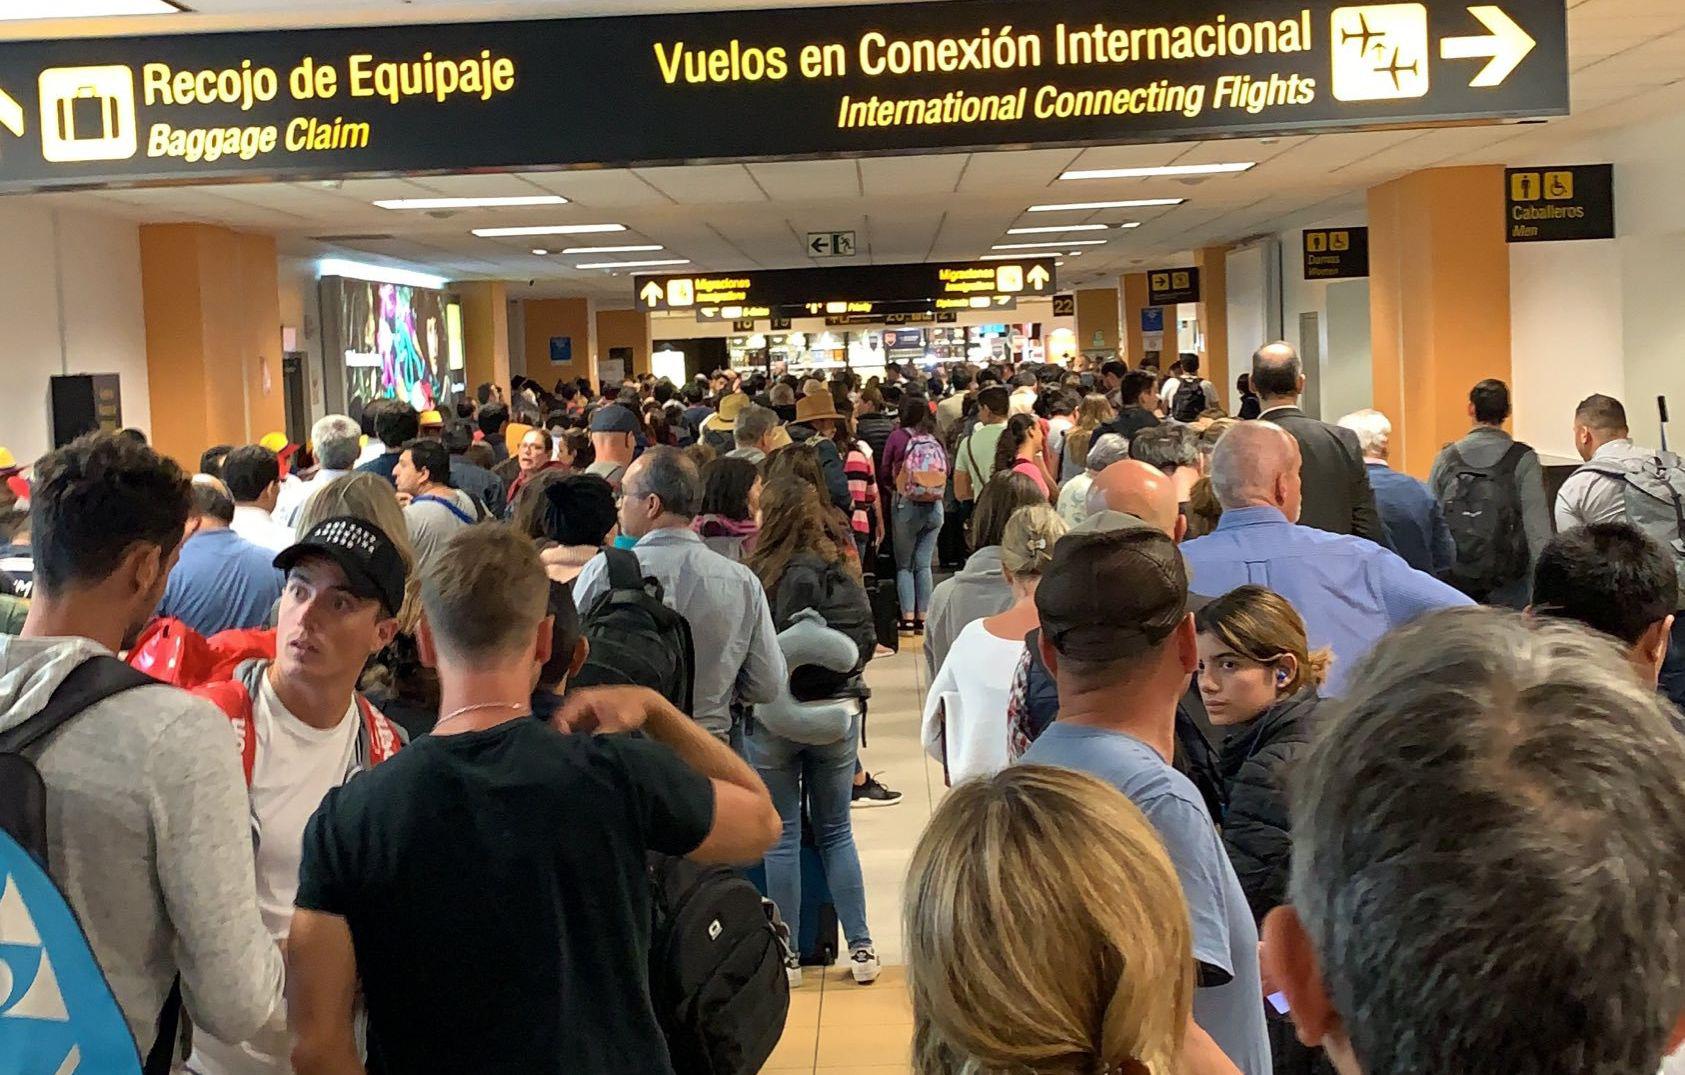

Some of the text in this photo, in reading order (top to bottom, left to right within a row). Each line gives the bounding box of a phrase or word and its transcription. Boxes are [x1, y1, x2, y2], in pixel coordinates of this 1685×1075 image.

[654, 10, 1312, 84] Vuelos en Conexión Internacional
[143, 50, 515, 111] Recojo de Equipaje
[838, 74, 1316, 128] International Connecting Flights
[147, 117, 370, 163] Baggage Claim
[1512, 205, 1584, 220] Caballeros
[1512, 225, 1538, 237] Men
[1054, 299, 1073, 314] 22
